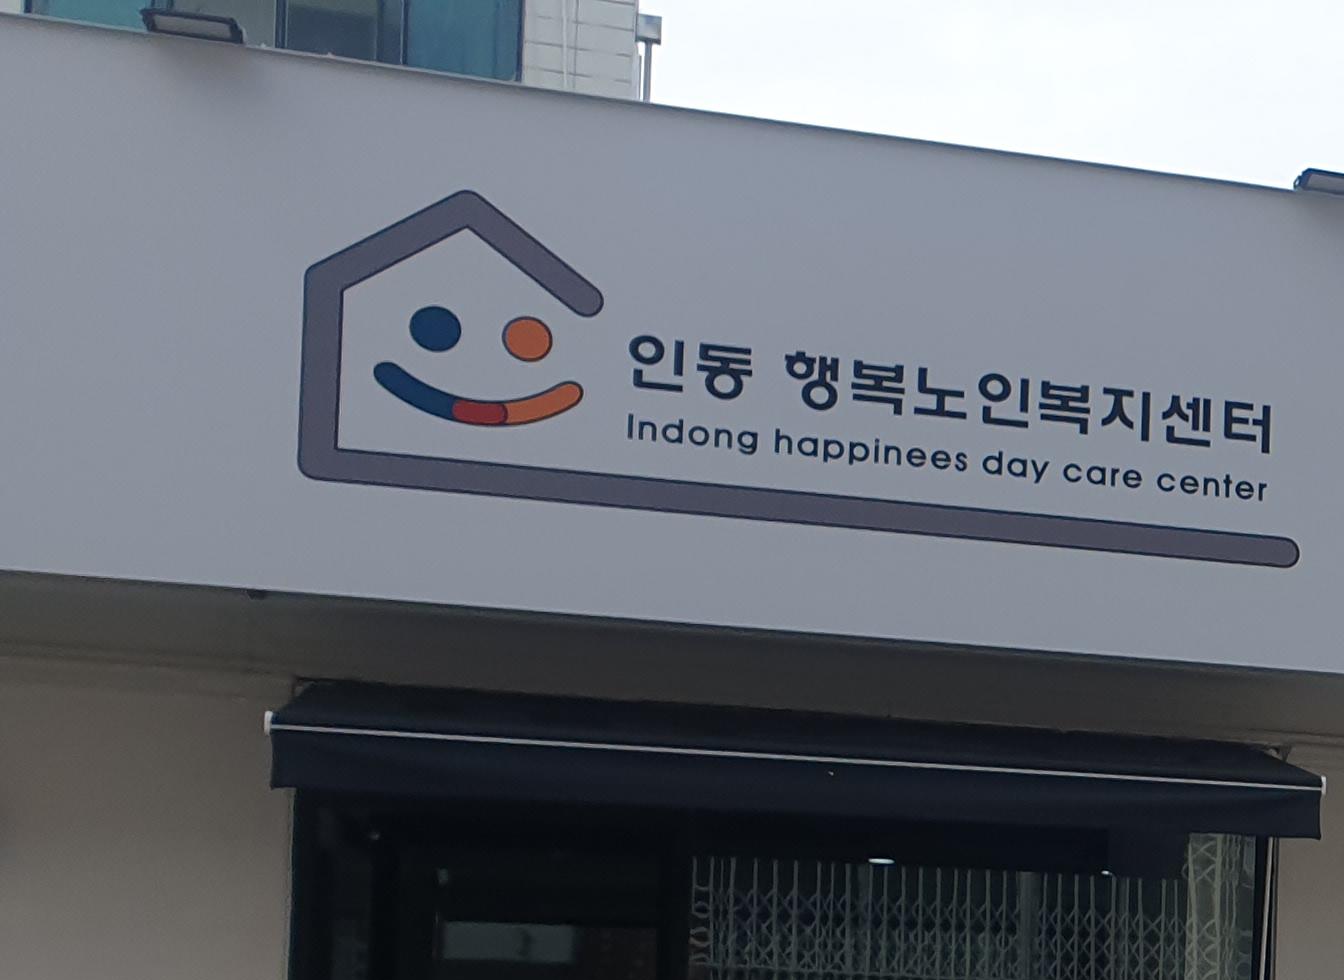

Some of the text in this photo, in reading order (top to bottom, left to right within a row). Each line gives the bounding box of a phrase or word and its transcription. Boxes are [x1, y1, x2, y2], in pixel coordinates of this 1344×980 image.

[627, 334, 1272, 455] 인동 행복노인복지센터
[627, 413, 1268, 502] Indong happinees day care center
